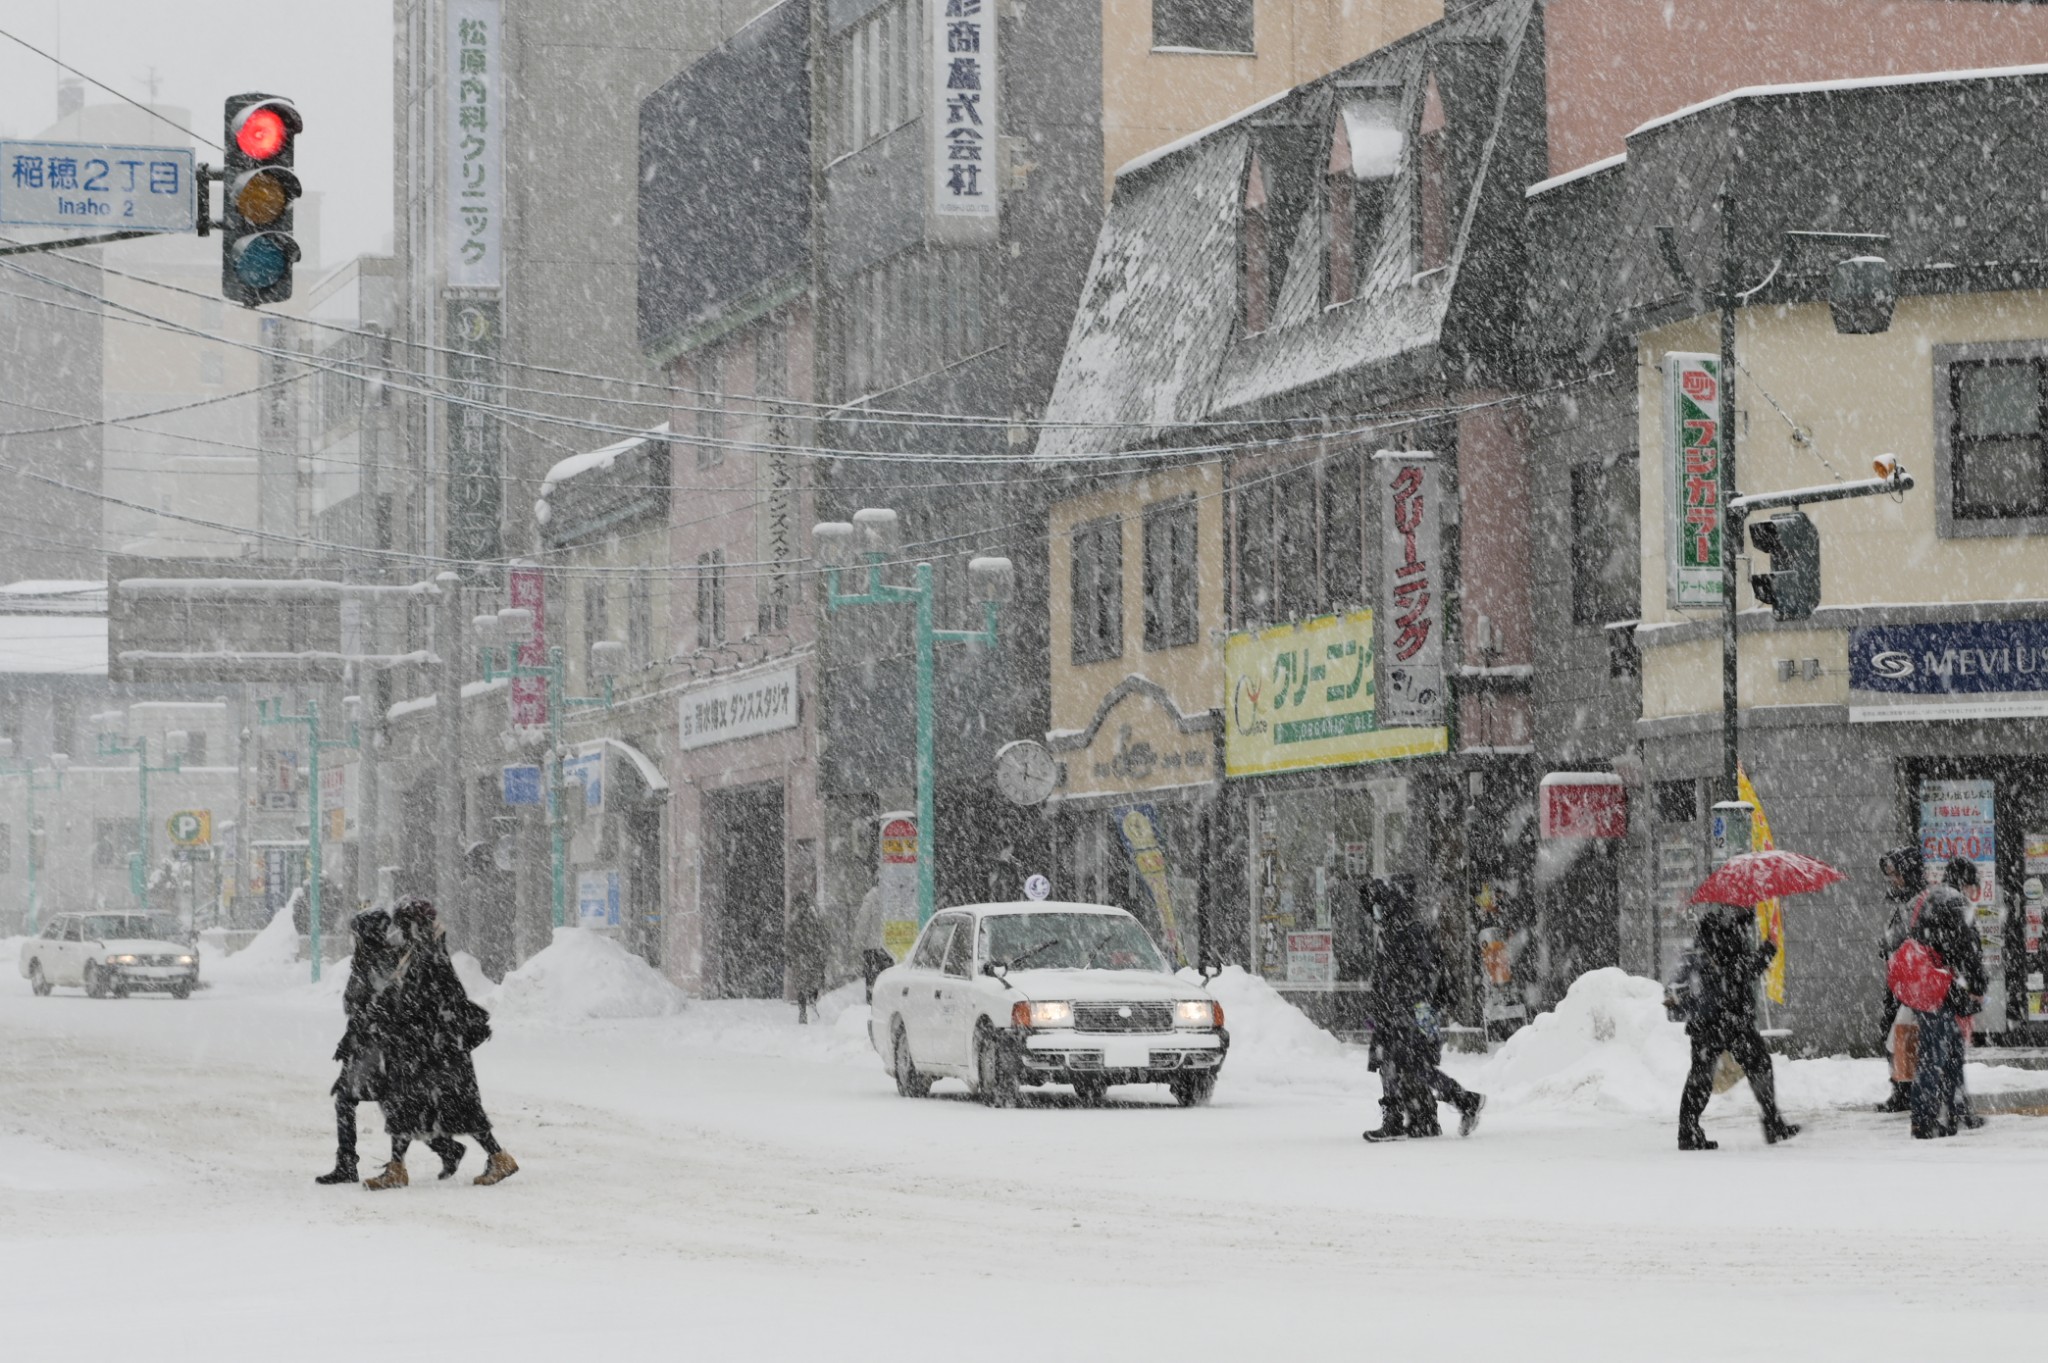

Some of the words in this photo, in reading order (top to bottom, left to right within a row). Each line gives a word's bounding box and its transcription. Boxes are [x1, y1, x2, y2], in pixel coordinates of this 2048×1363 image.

[458, 18, 487, 265] 松原内科クリニック
[12, 155, 179, 195] 稲穂2丁目
[59, 197, 111, 215] Inaho
[123, 200, 134, 217] 2
[1684, 419, 1717, 564] フジカラー
[1391, 466, 1431, 663] クリーニング
[731, 681, 789, 726] ダンススタジオ
[178, 815, 197, 839] P
